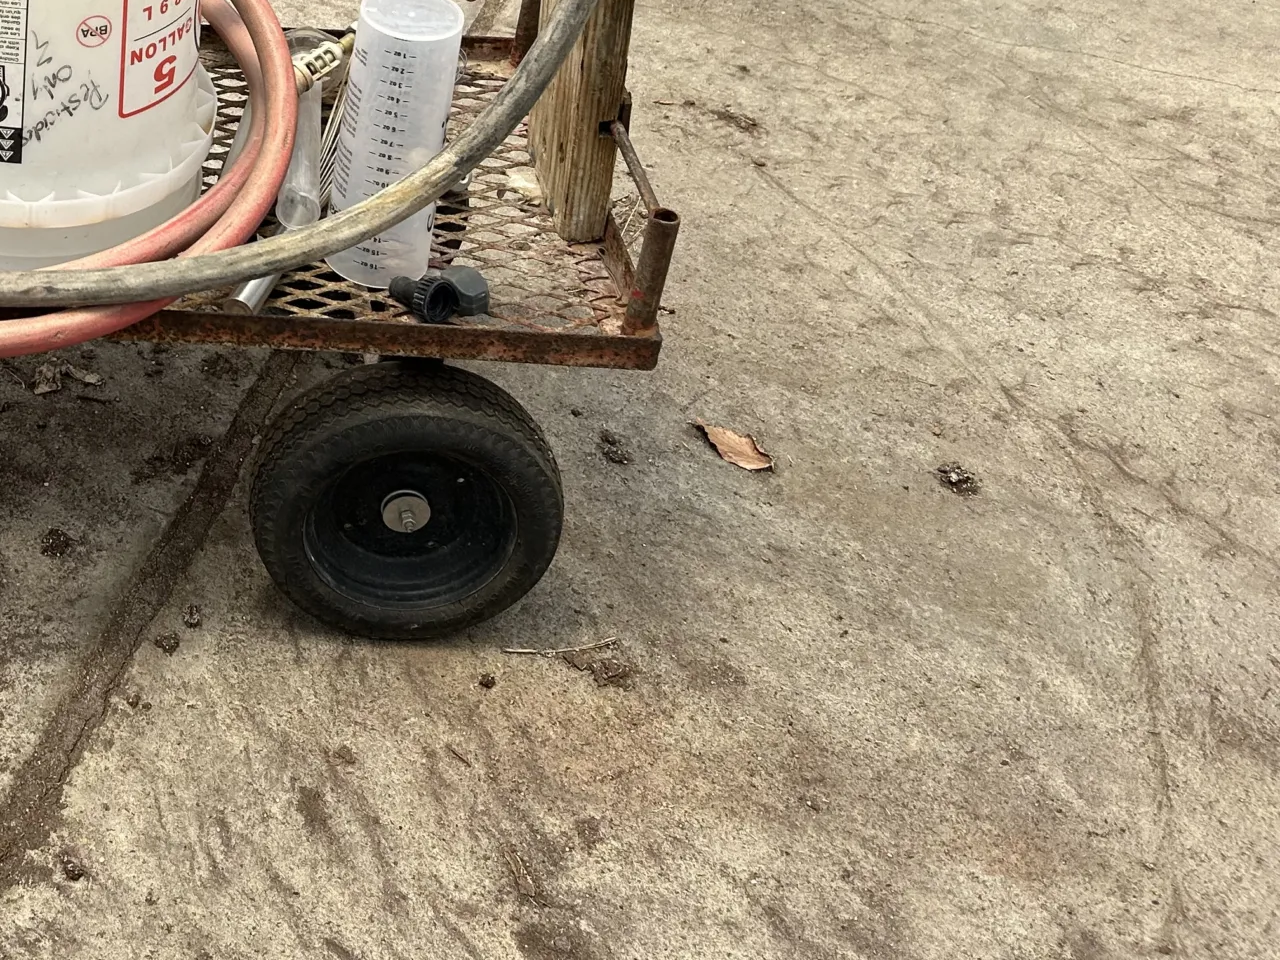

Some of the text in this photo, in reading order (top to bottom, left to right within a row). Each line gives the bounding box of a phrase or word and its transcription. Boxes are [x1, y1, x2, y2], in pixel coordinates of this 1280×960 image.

[143, 6, 152, 21] L
[81, 25, 108, 38] BPA
[130, 17, 192, 66] GALLON
[154, 55, 176, 94] 5
